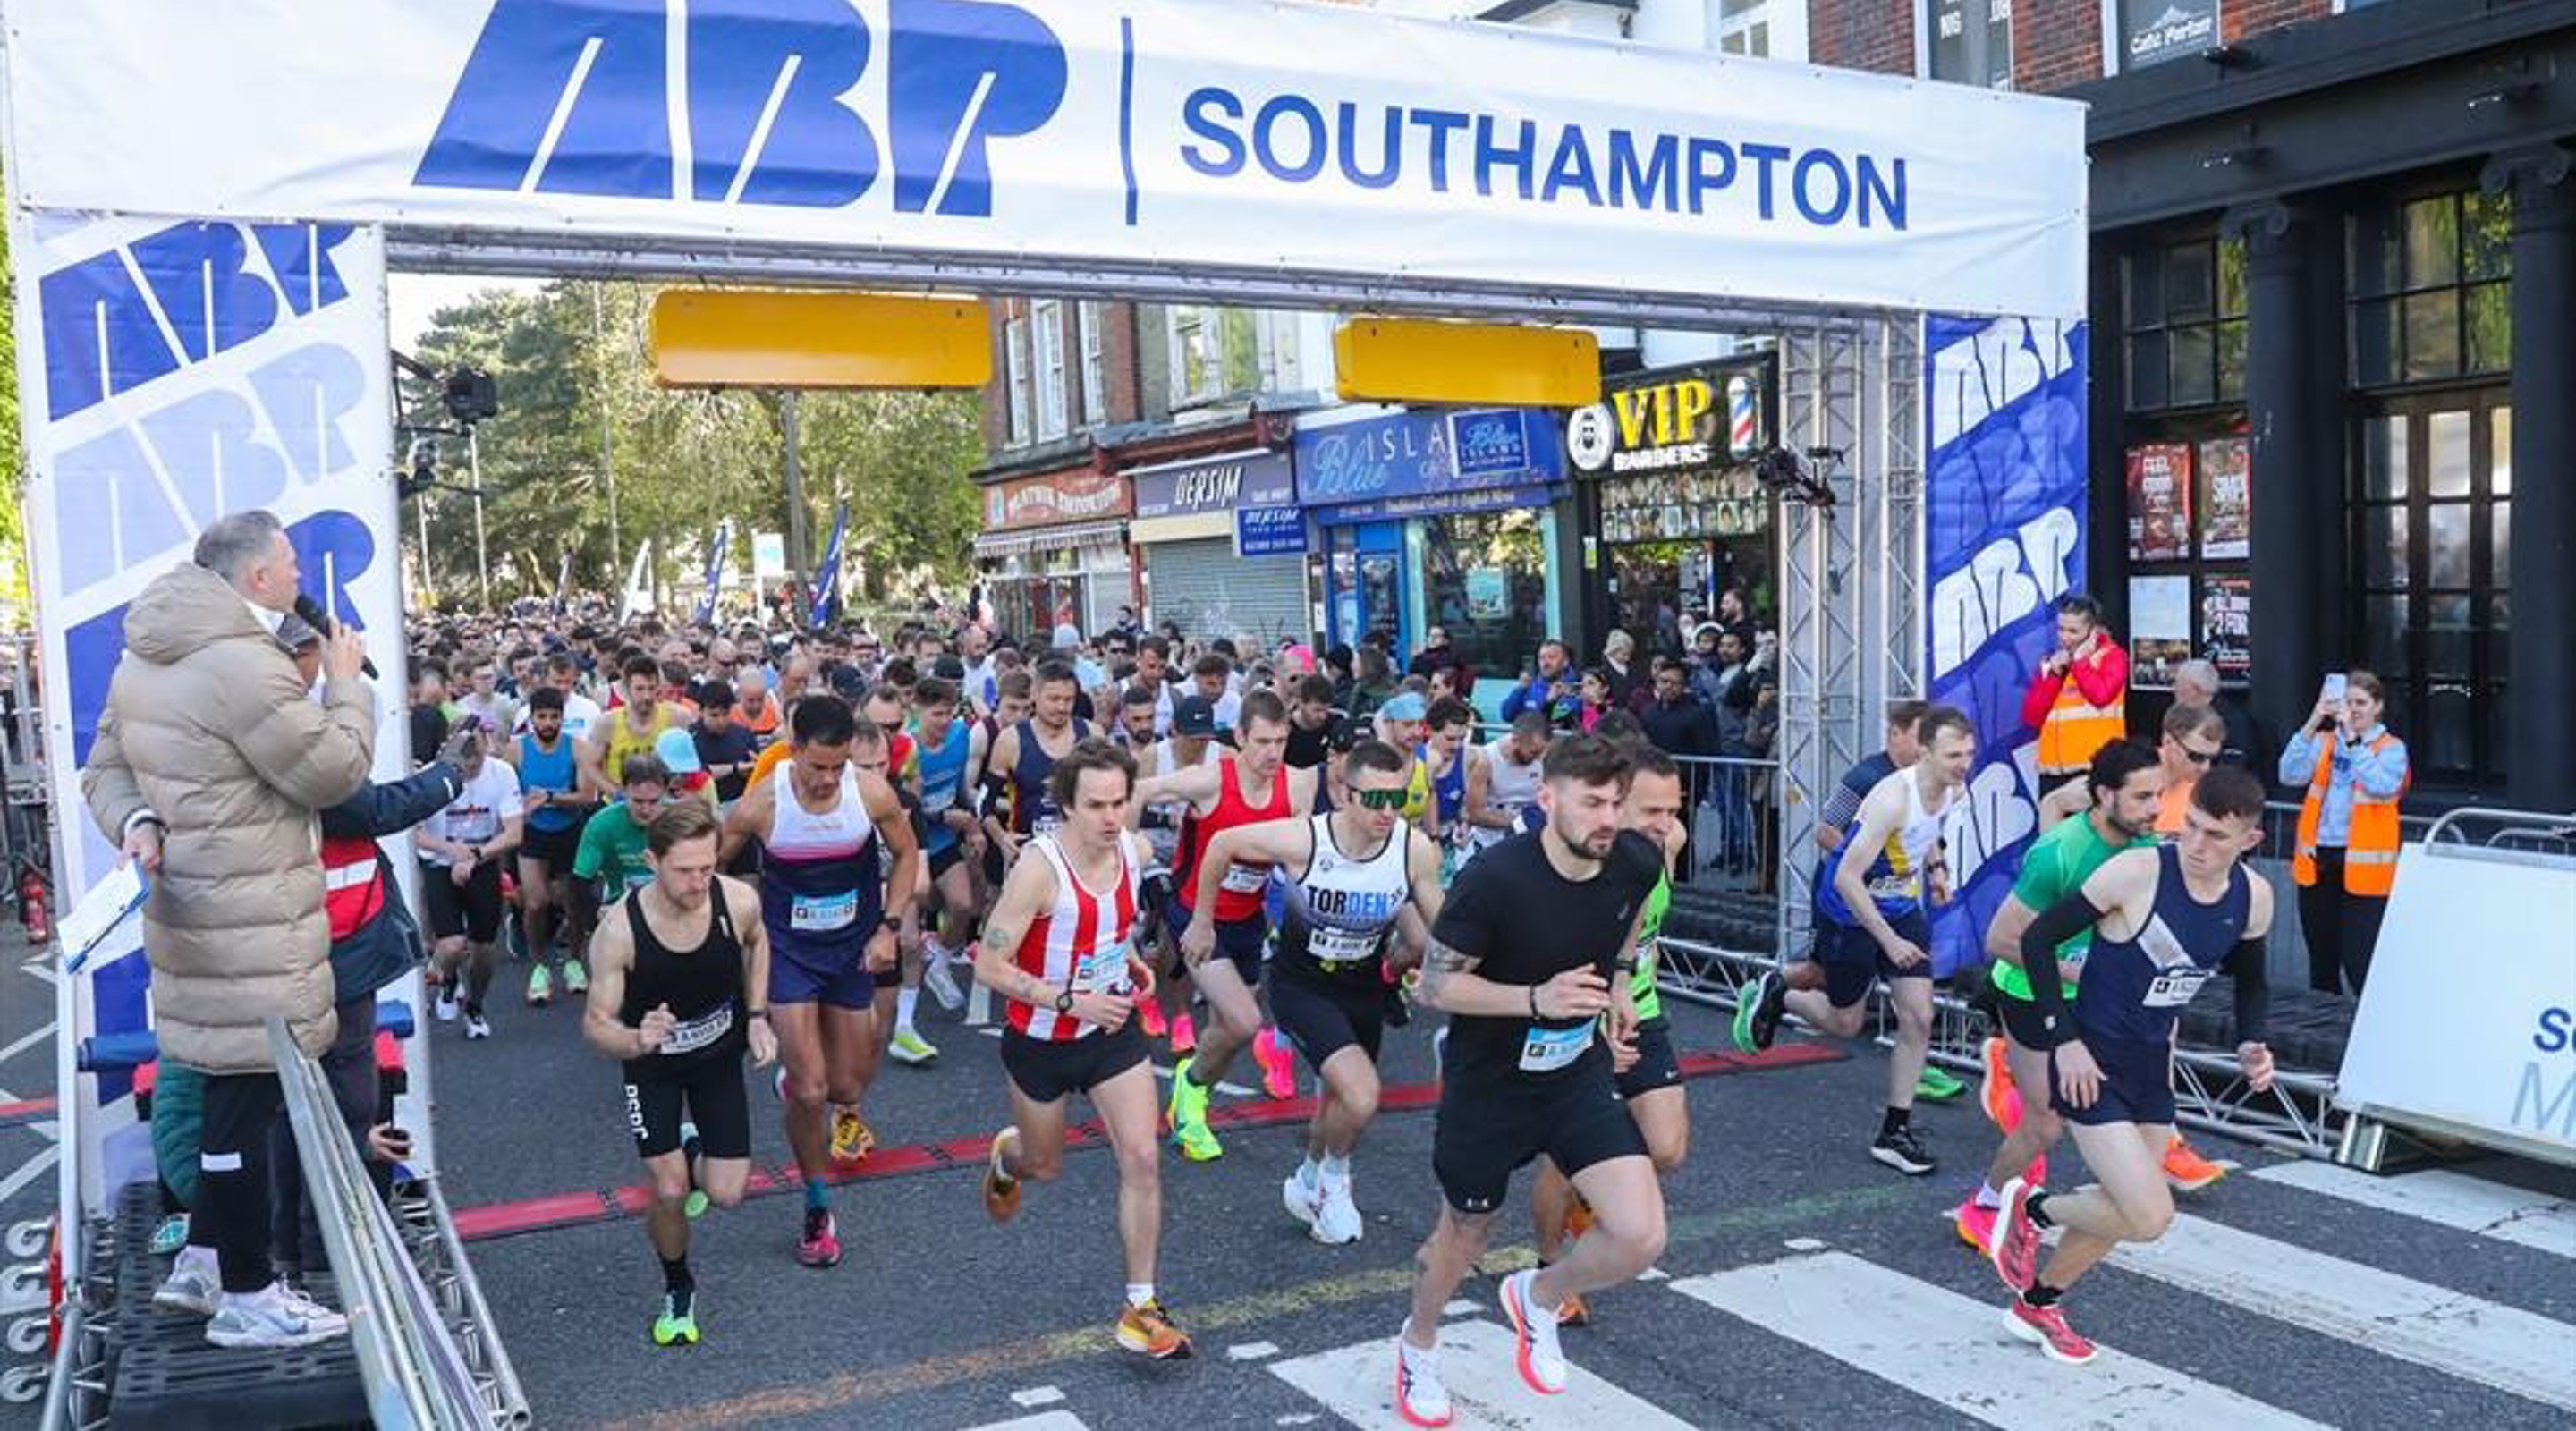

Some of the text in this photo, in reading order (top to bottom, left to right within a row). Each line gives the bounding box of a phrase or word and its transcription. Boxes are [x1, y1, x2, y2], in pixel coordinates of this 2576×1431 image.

[1180, 86, 1908, 232] SOUTHAMPTON
[1613, 378, 1712, 448] VIP
[1613, 444, 1709, 472] BARBERS
[1174, 466, 1242, 511] DERSIM
[1306, 884, 1387, 917] TORDEN
